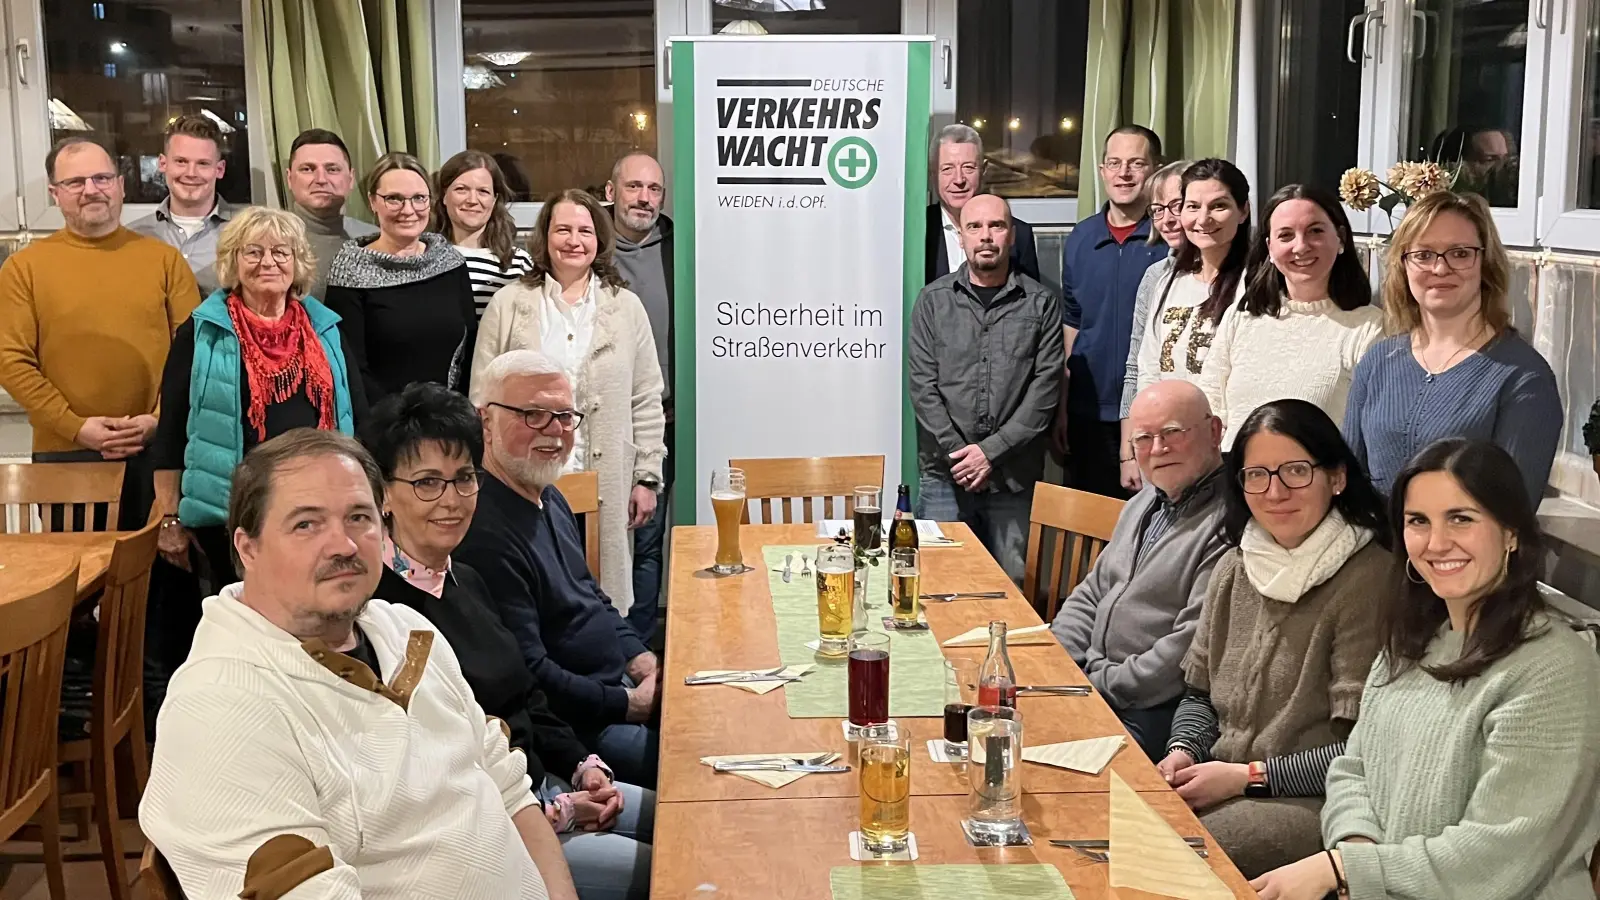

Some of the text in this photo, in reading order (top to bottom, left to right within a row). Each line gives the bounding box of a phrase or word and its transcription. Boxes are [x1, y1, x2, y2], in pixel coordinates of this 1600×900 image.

[813, 78, 885, 92] DEUTSCHE
[716, 97, 882, 130] VERKEHRS
[716, 135, 828, 167] WACHT
[717, 195, 775, 209] WEIDEN
[716, 301, 883, 327] Sicherheit im
[711, 335, 887, 359] Straßenverkehr
